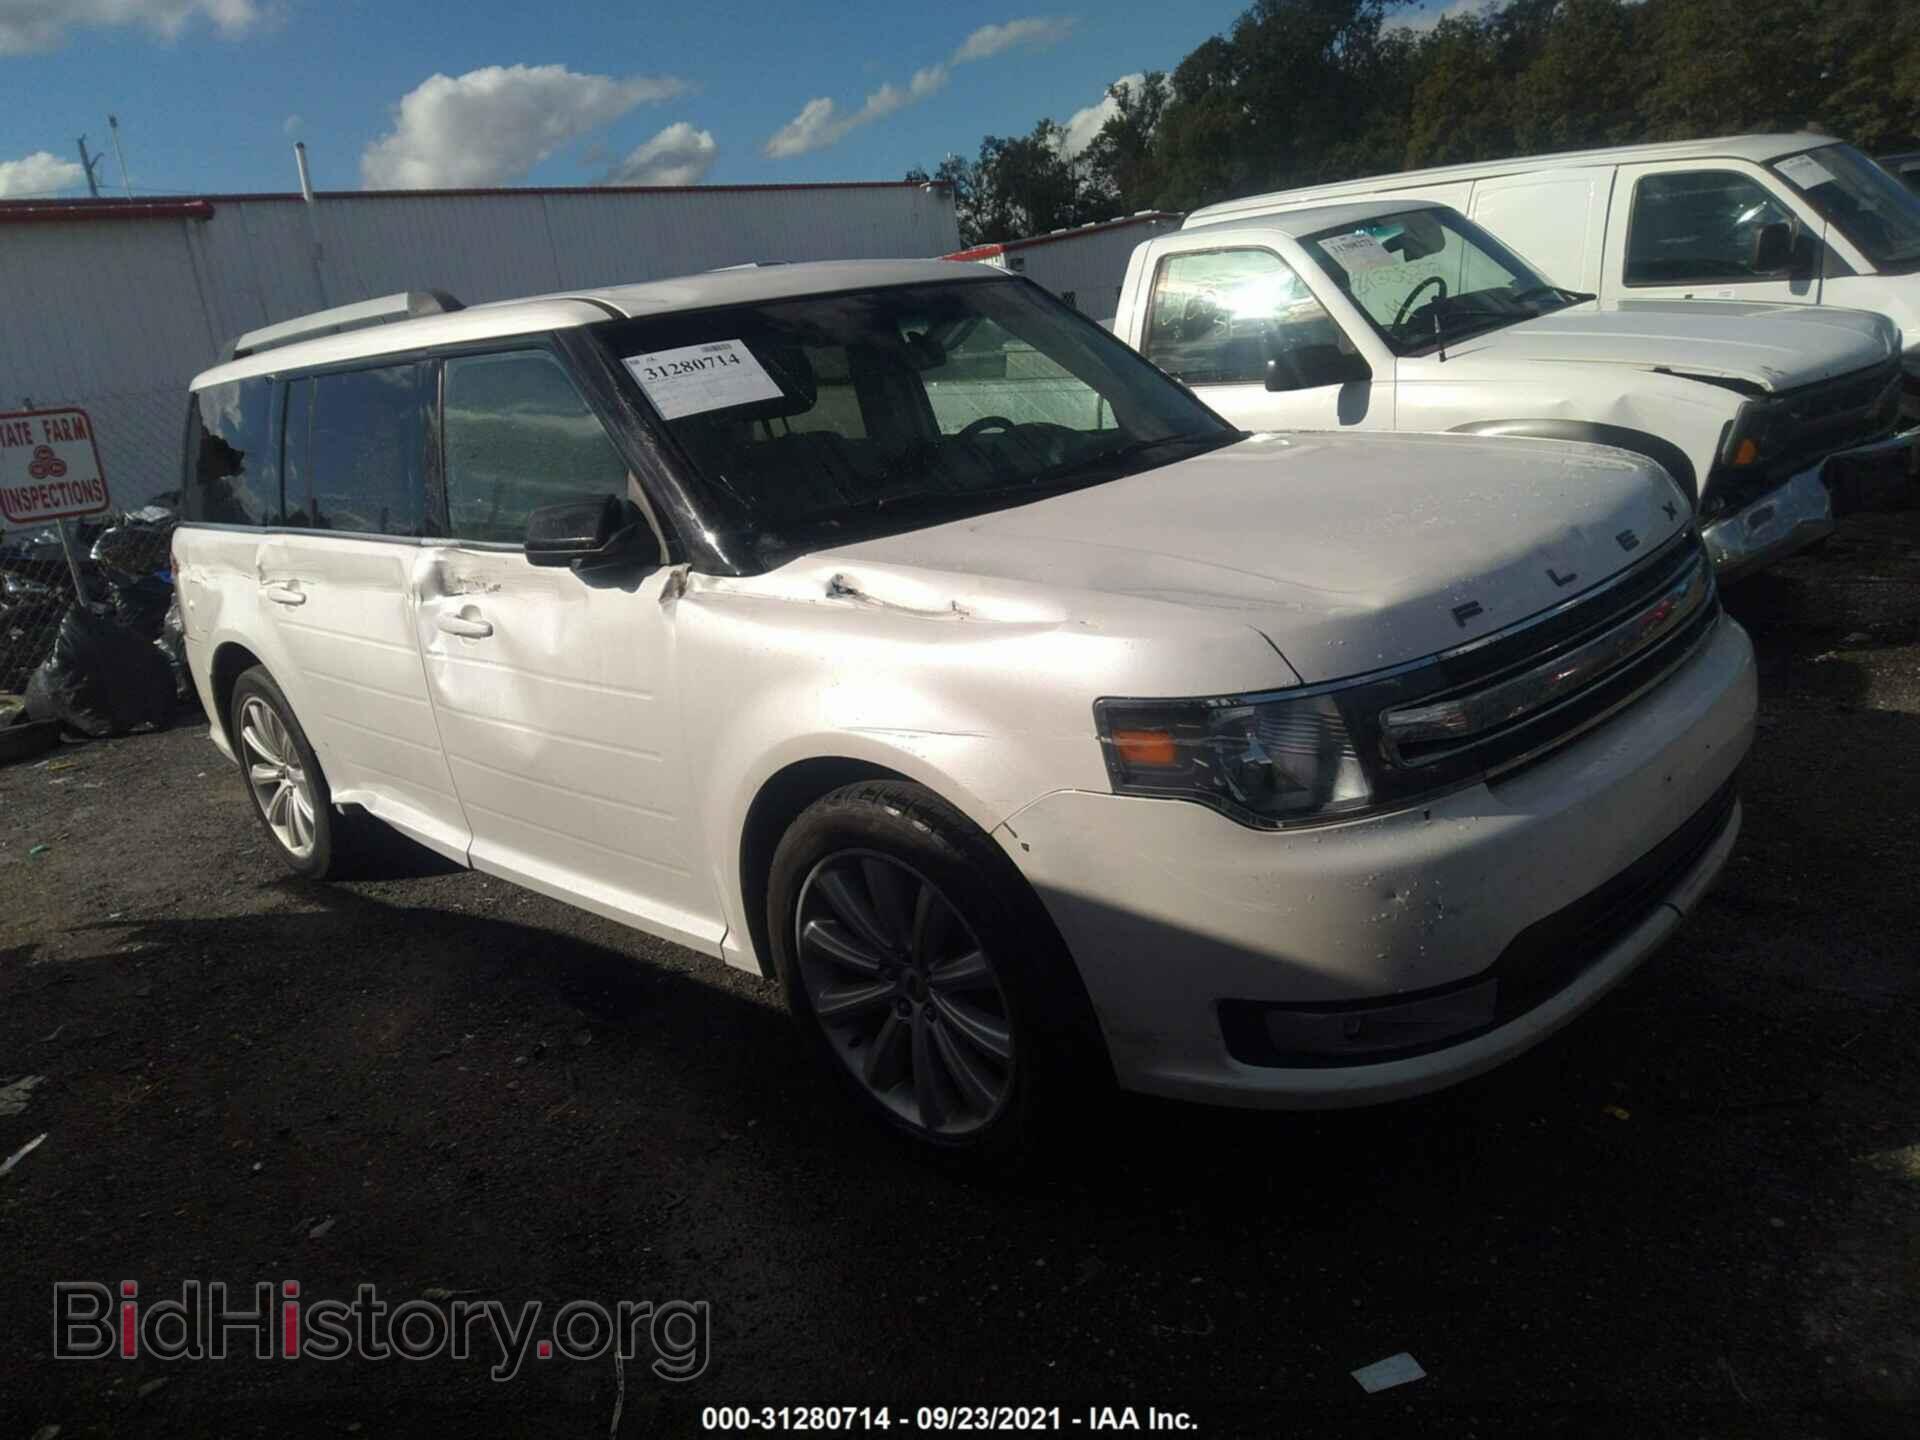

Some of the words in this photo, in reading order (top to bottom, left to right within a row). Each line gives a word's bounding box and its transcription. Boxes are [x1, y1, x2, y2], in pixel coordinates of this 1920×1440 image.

[643, 353, 741, 381] 31280714
[43, 415, 88, 443] FARM
[4, 478, 103, 513] INSPECTIONS
[1451, 501, 1679, 629] FLEX
